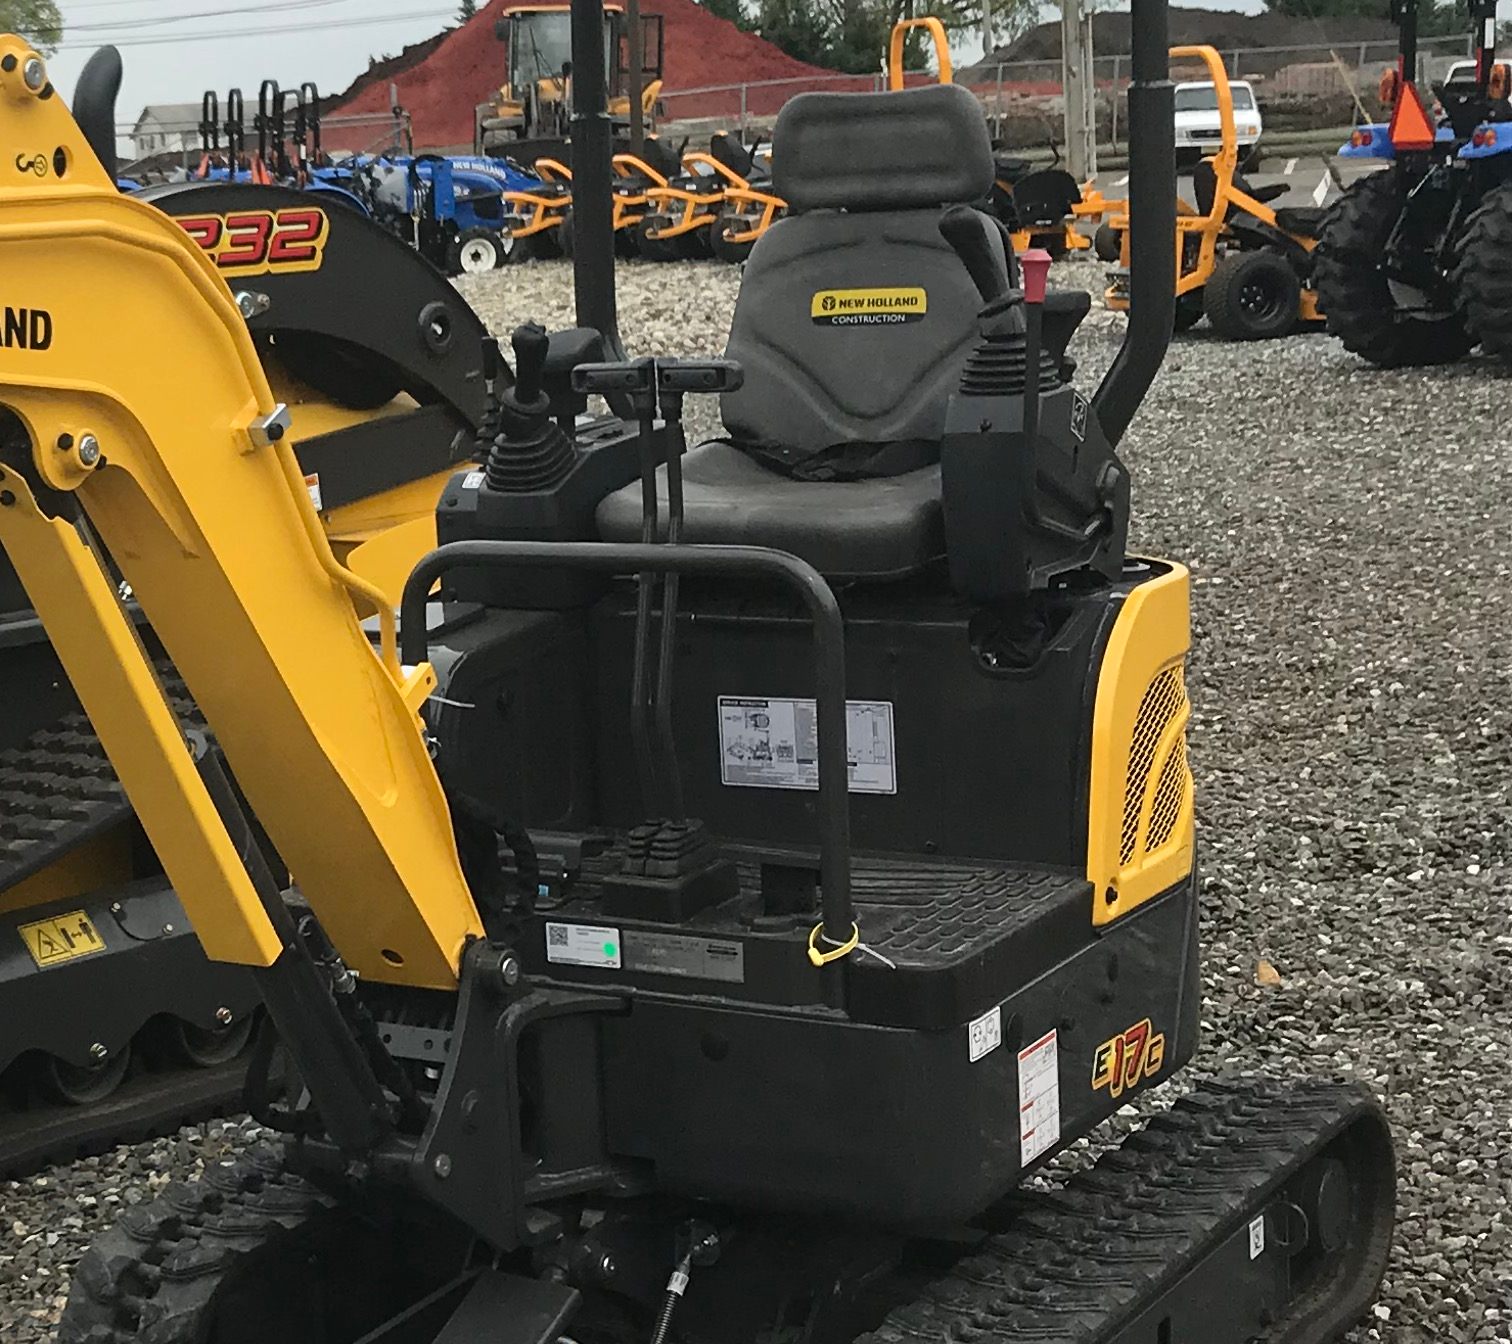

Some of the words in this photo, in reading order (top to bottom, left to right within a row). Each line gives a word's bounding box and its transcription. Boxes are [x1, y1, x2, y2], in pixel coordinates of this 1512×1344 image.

[839, 298, 865, 309] NEW
[867, 296, 918, 308] HOLLAND
[831, 314, 906, 325] CONSTRUCTION
